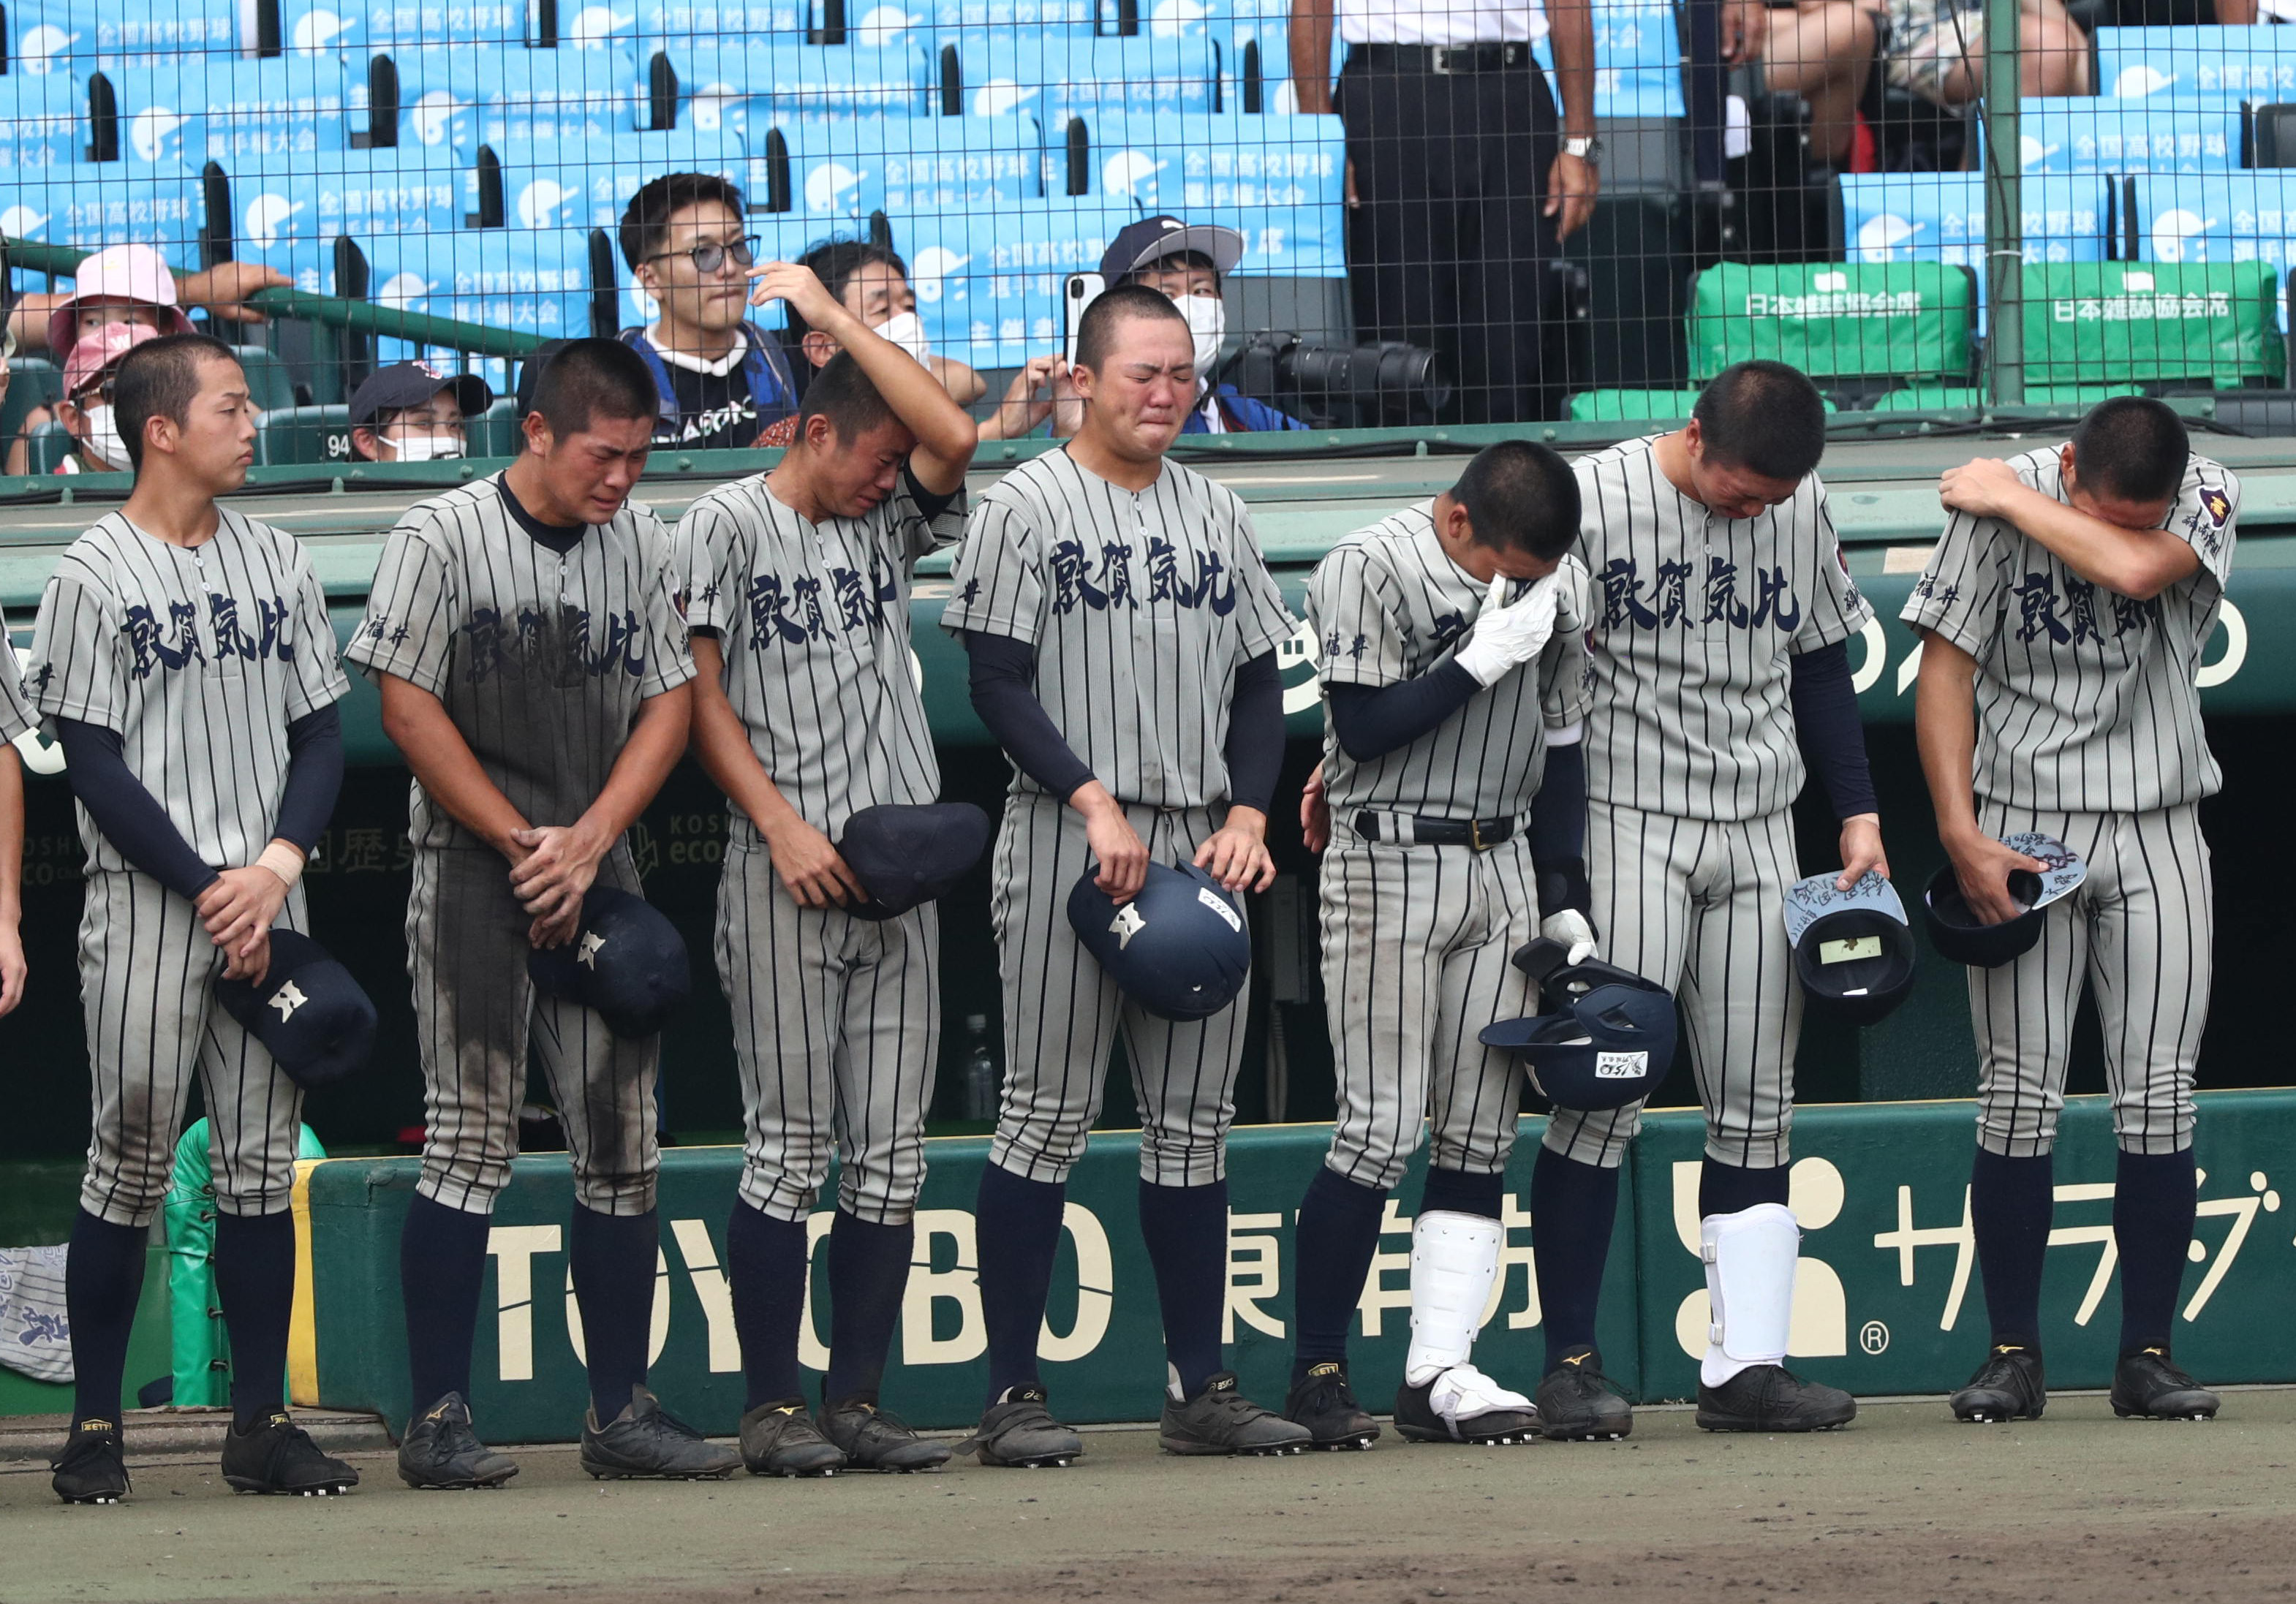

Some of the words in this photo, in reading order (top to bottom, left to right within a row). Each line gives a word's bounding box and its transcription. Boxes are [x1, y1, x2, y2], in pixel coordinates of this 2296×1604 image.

[1941, 210, 2096, 238] 全国校野球
[1745, 291, 1922, 319] 日本雑誌協会席
[2053, 290, 2230, 322] 日本雑誌協会席
[328, 434, 350, 458] 94
[1050, 537, 1236, 616] 敦賀気比
[1596, 557, 1801, 632] 敦賀気比
[121, 593, 293, 681] 敦賀気比
[83, 1423, 111, 1431] ZETT
